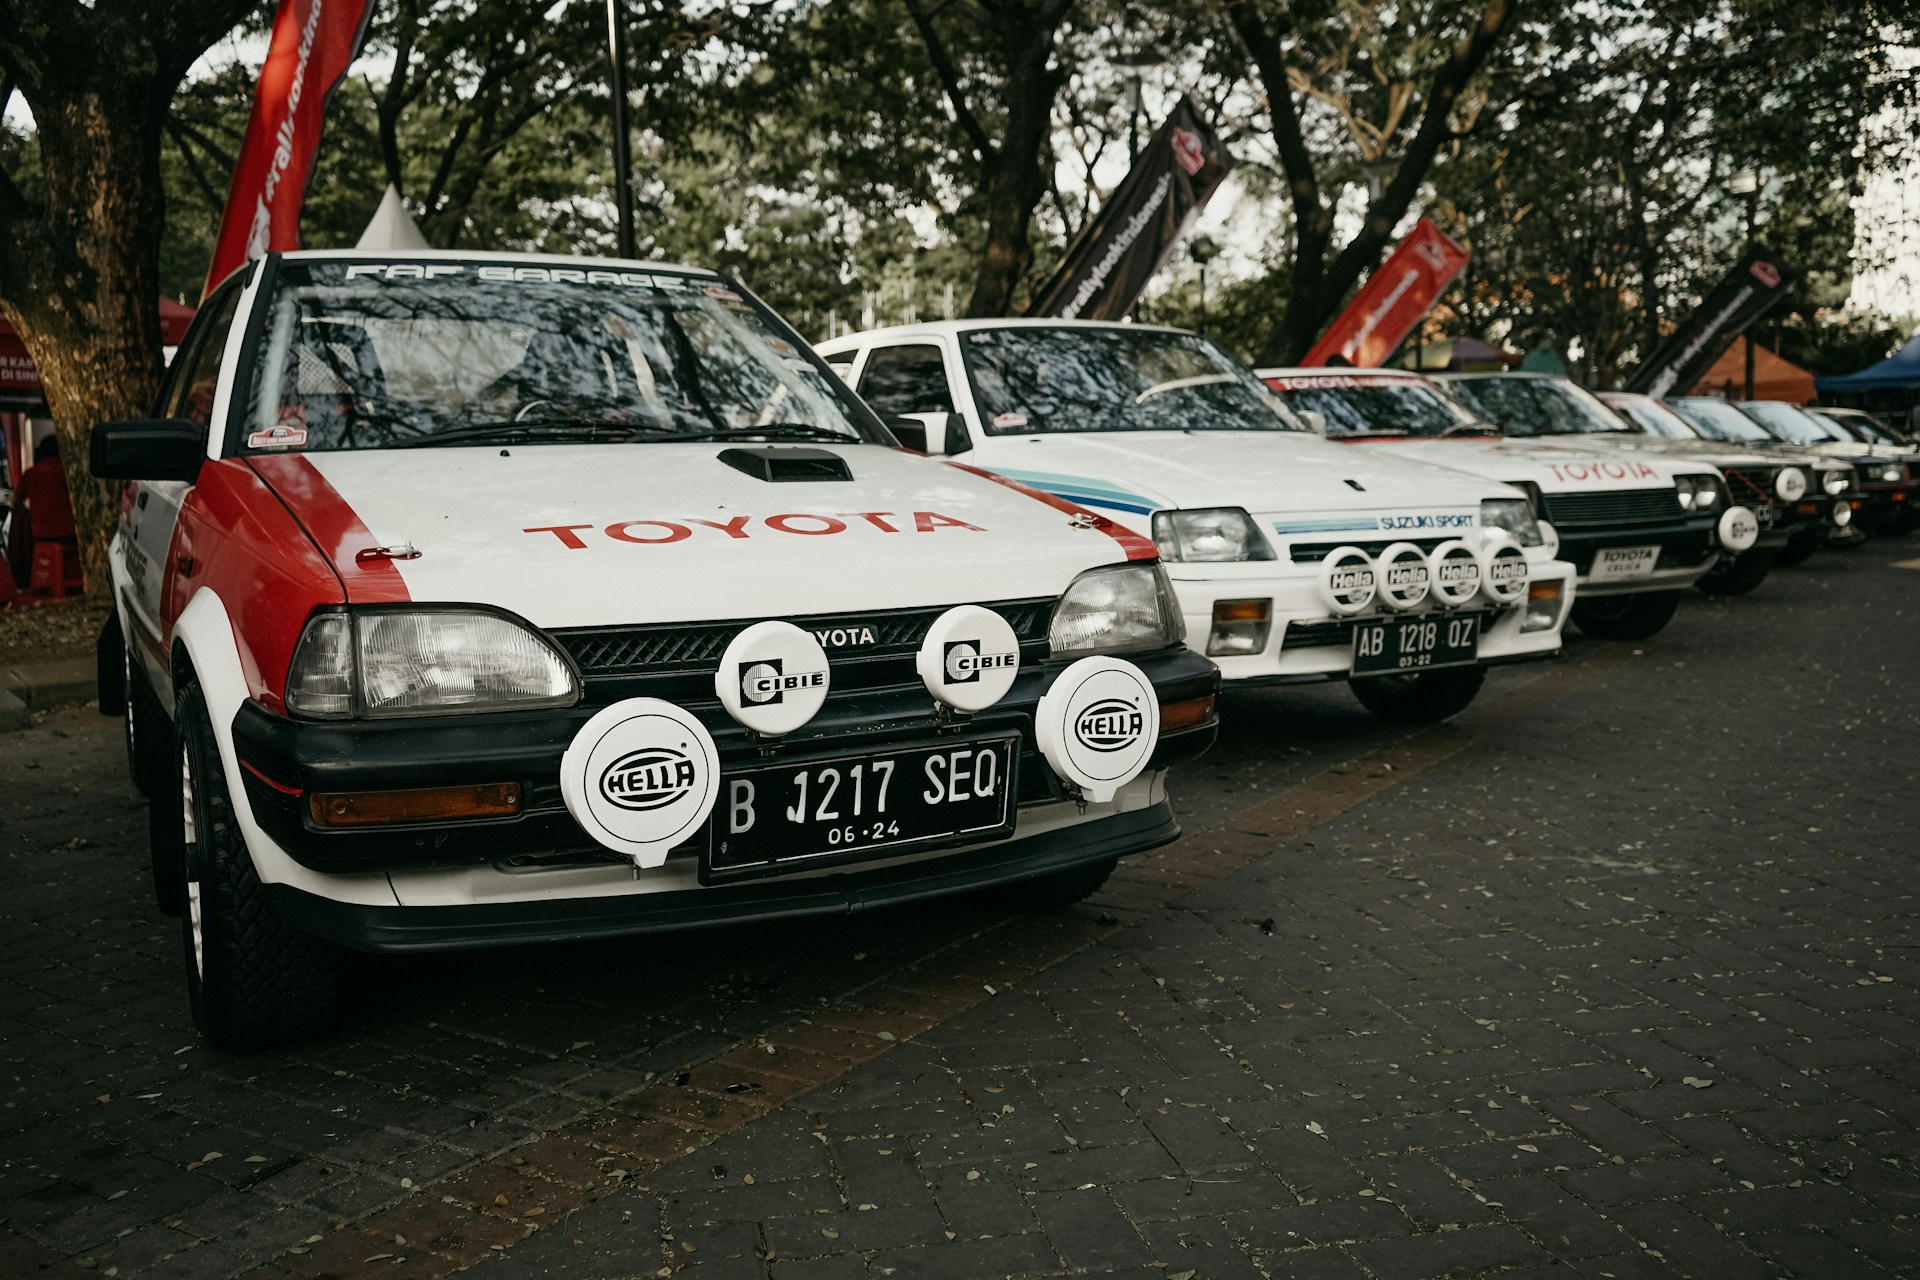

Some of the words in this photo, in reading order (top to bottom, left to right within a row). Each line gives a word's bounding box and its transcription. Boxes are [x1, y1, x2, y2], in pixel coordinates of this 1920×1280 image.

[345, 264, 464, 280] FAF
[477, 266, 688, 291] GARAGE
[1546, 460, 1659, 482] TOYOTA
[522, 511, 989, 550] TOYOTA
[1381, 515, 1435, 530] SUZUKI
[1437, 514, 1474, 528] SPORT
[1603, 548, 1653, 562] TOYOTA
[1332, 571, 1374, 589] Hella
[1389, 567, 1429, 585] Hella
[1440, 564, 1479, 581] Hella
[1492, 562, 1528, 579] Hella
[813, 627, 876, 648] YOTA
[1359, 627, 1385, 657] AB
[1399, 622, 1438, 653] 1218
[1080, 712, 1143, 735] HELLA
[607, 759, 695, 793] HELLA
[730, 779, 756, 834] B
[923, 749, 998, 805] SEQ
